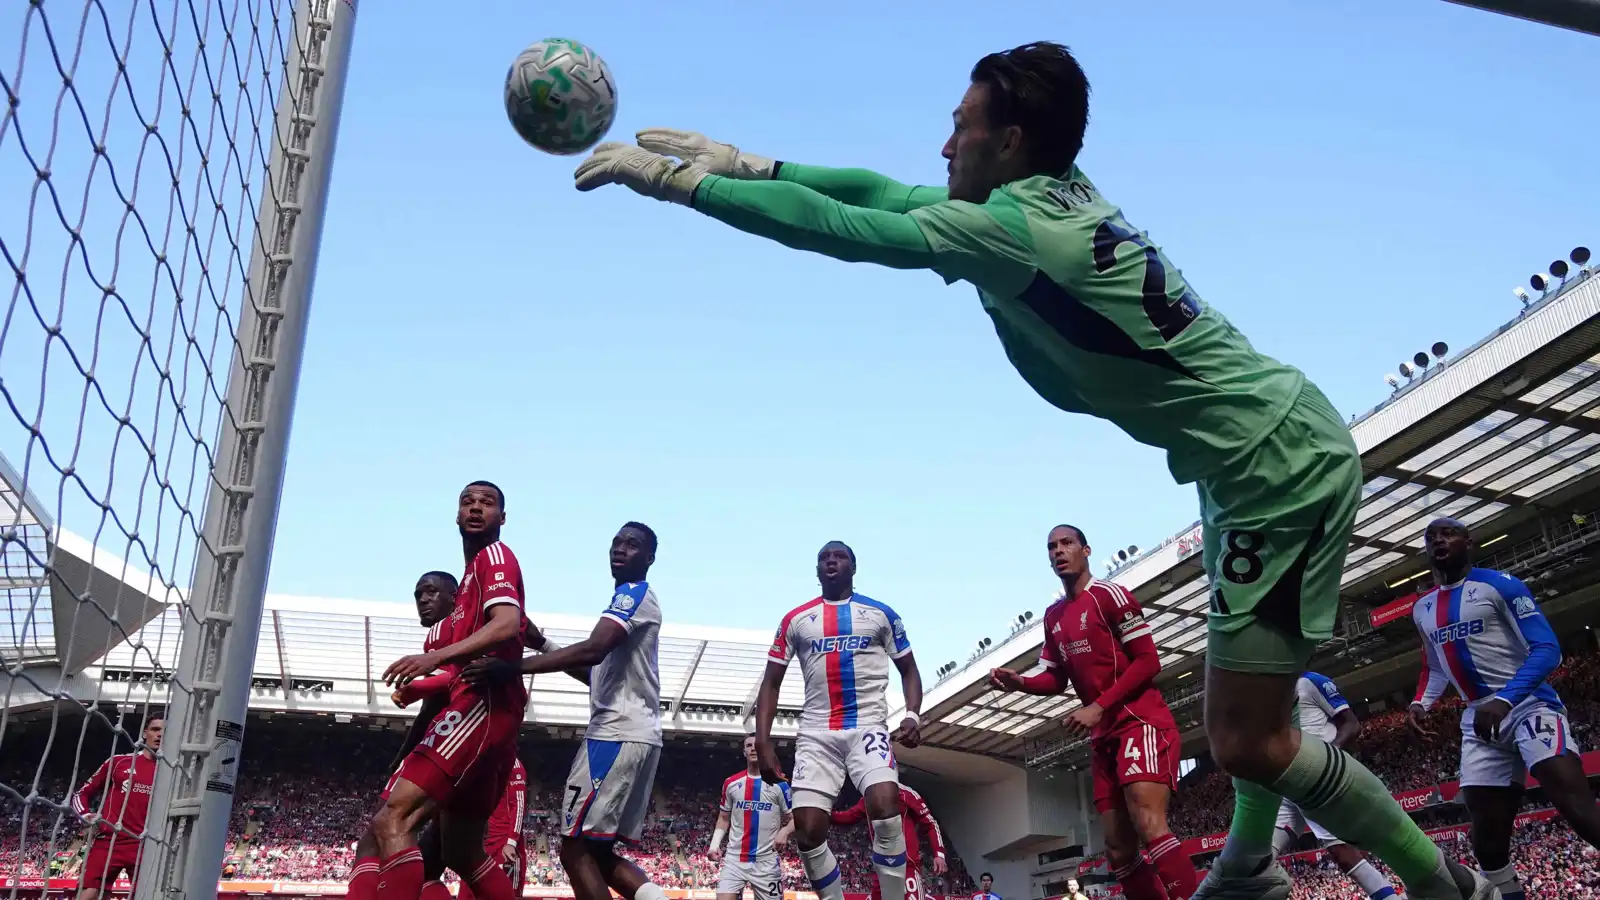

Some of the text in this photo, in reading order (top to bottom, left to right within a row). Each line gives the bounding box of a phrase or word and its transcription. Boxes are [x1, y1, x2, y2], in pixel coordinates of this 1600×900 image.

[1092, 220, 1203, 344] 2
[1222, 531, 1265, 584] 8
[810, 635, 873, 654] NET88
[1429, 618, 1485, 646] NET88
[434, 710, 463, 737] 8
[1521, 715, 1556, 740] 14
[862, 731, 890, 755] 23
[1124, 737, 1142, 761] 4
[568, 785, 582, 812] 7
[735, 800, 773, 811] NET88
[1208, 835, 1229, 848] Exped
